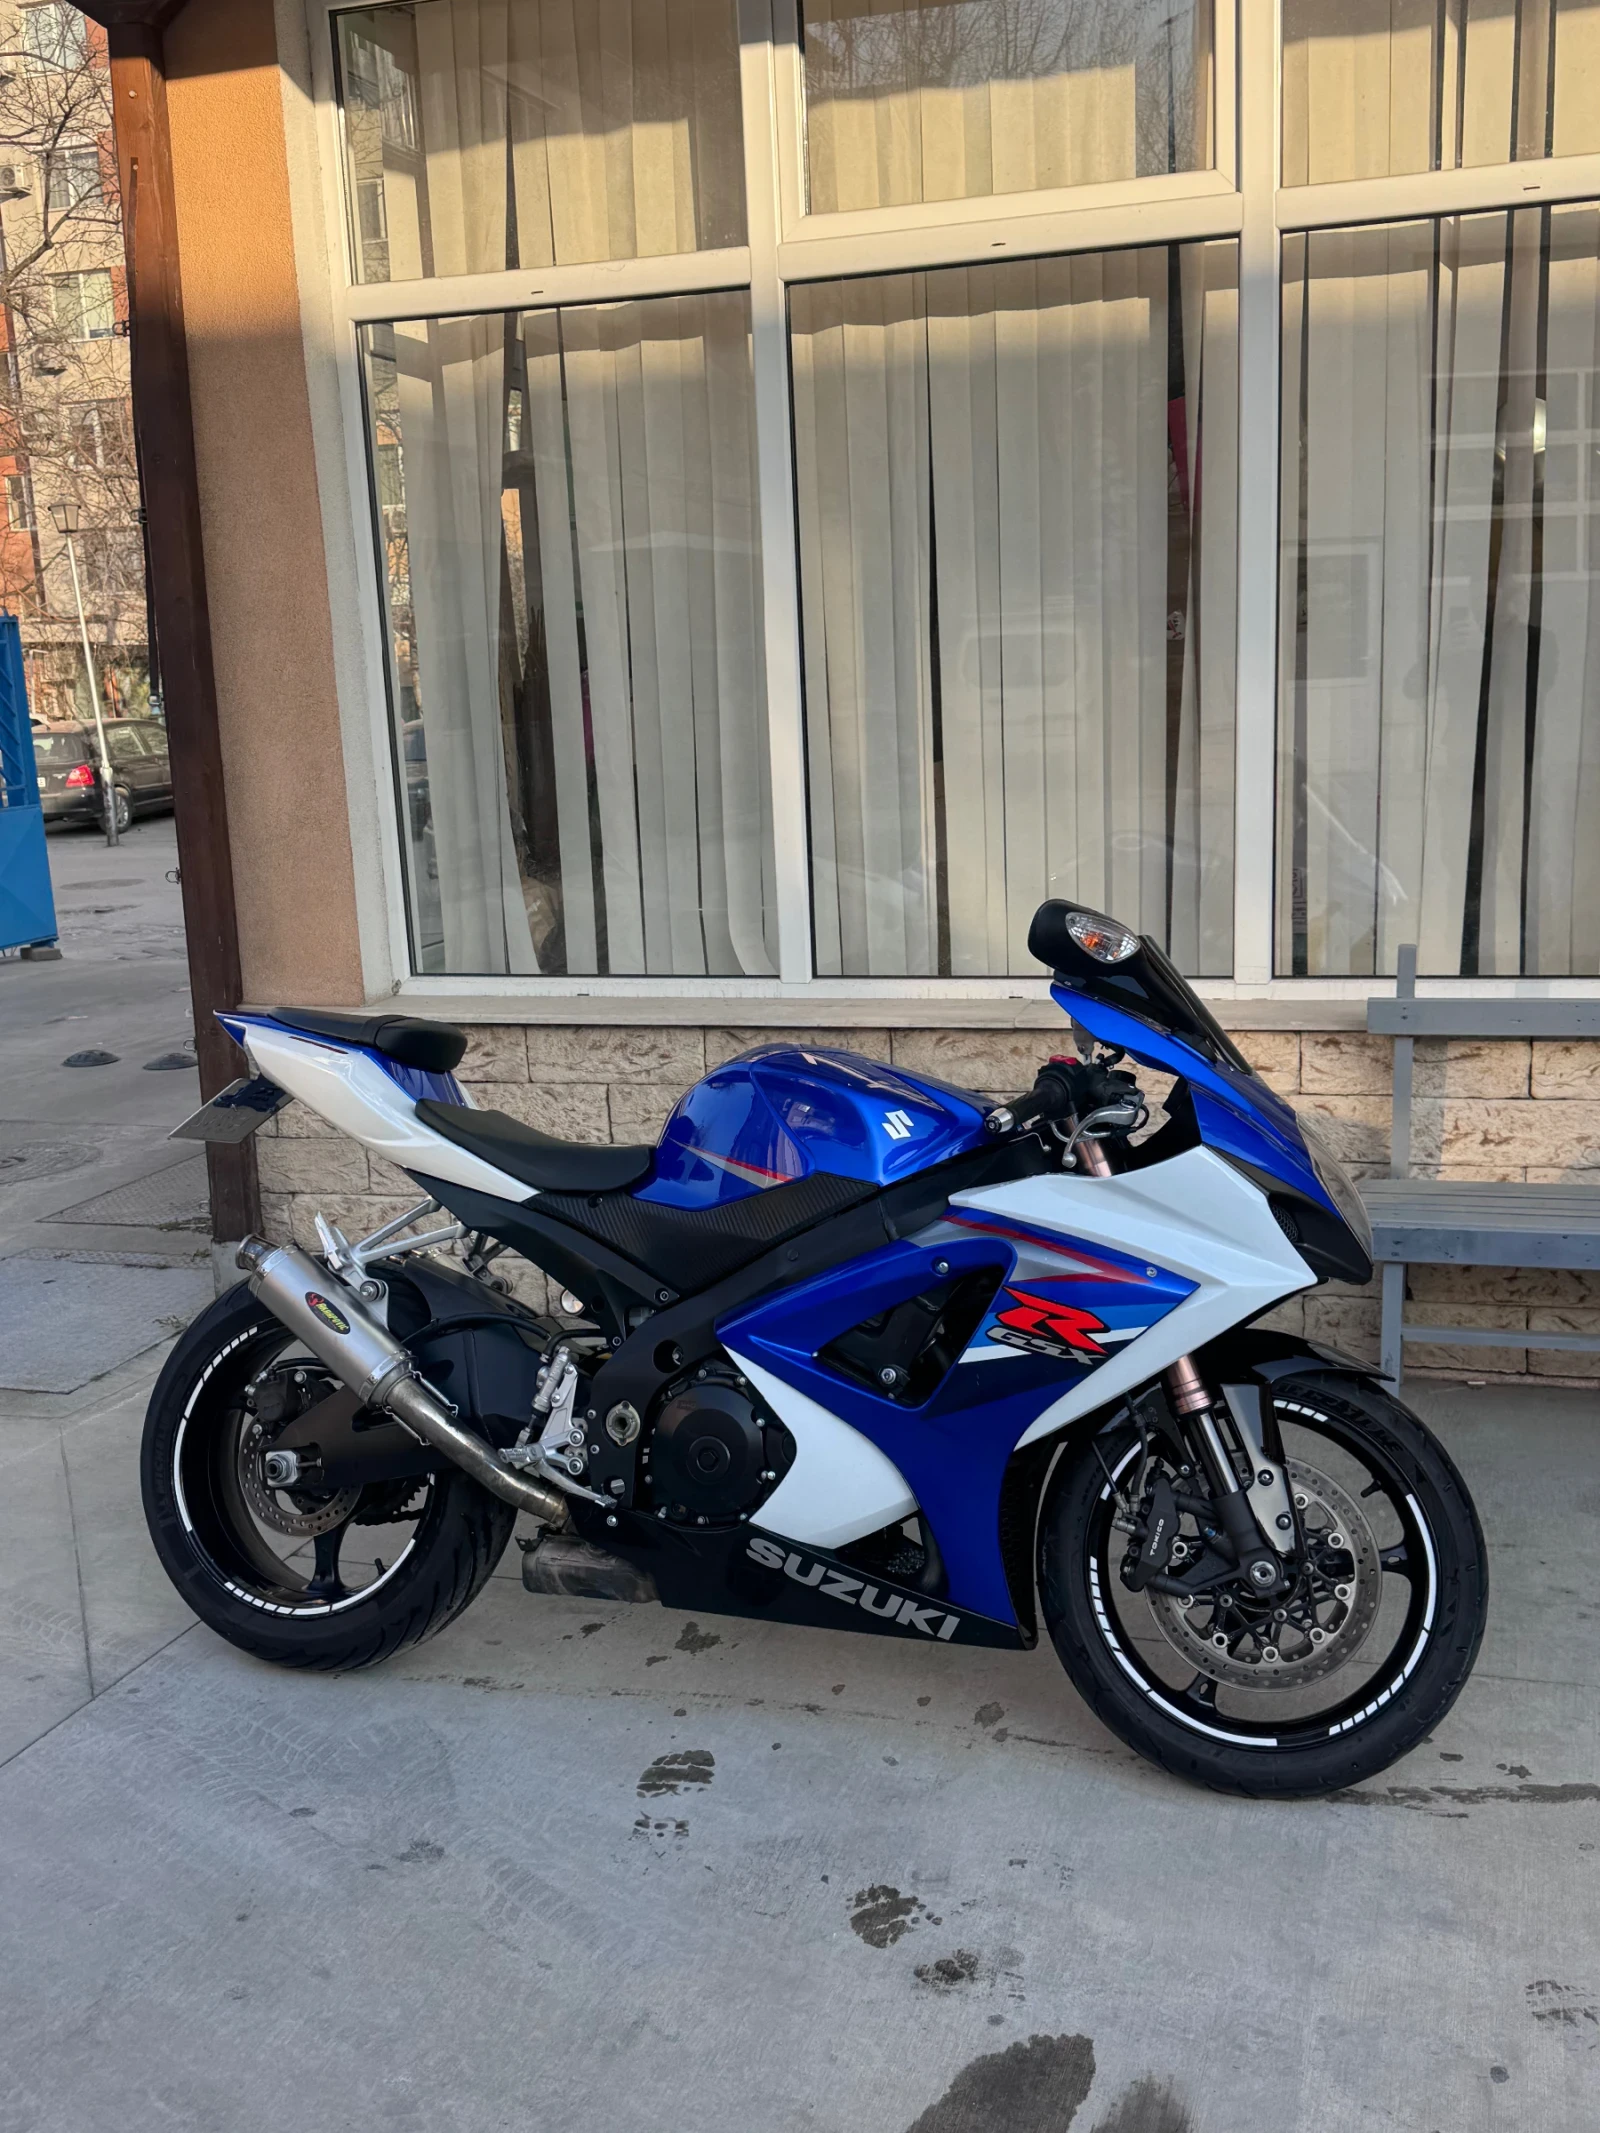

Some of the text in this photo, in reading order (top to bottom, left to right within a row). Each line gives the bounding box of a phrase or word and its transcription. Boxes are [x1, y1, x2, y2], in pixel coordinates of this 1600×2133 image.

[986, 1326, 1107, 1366] GSX
[1149, 1518, 1165, 1556] TOKICO
[746, 1537, 960, 1641] SUZUKI
